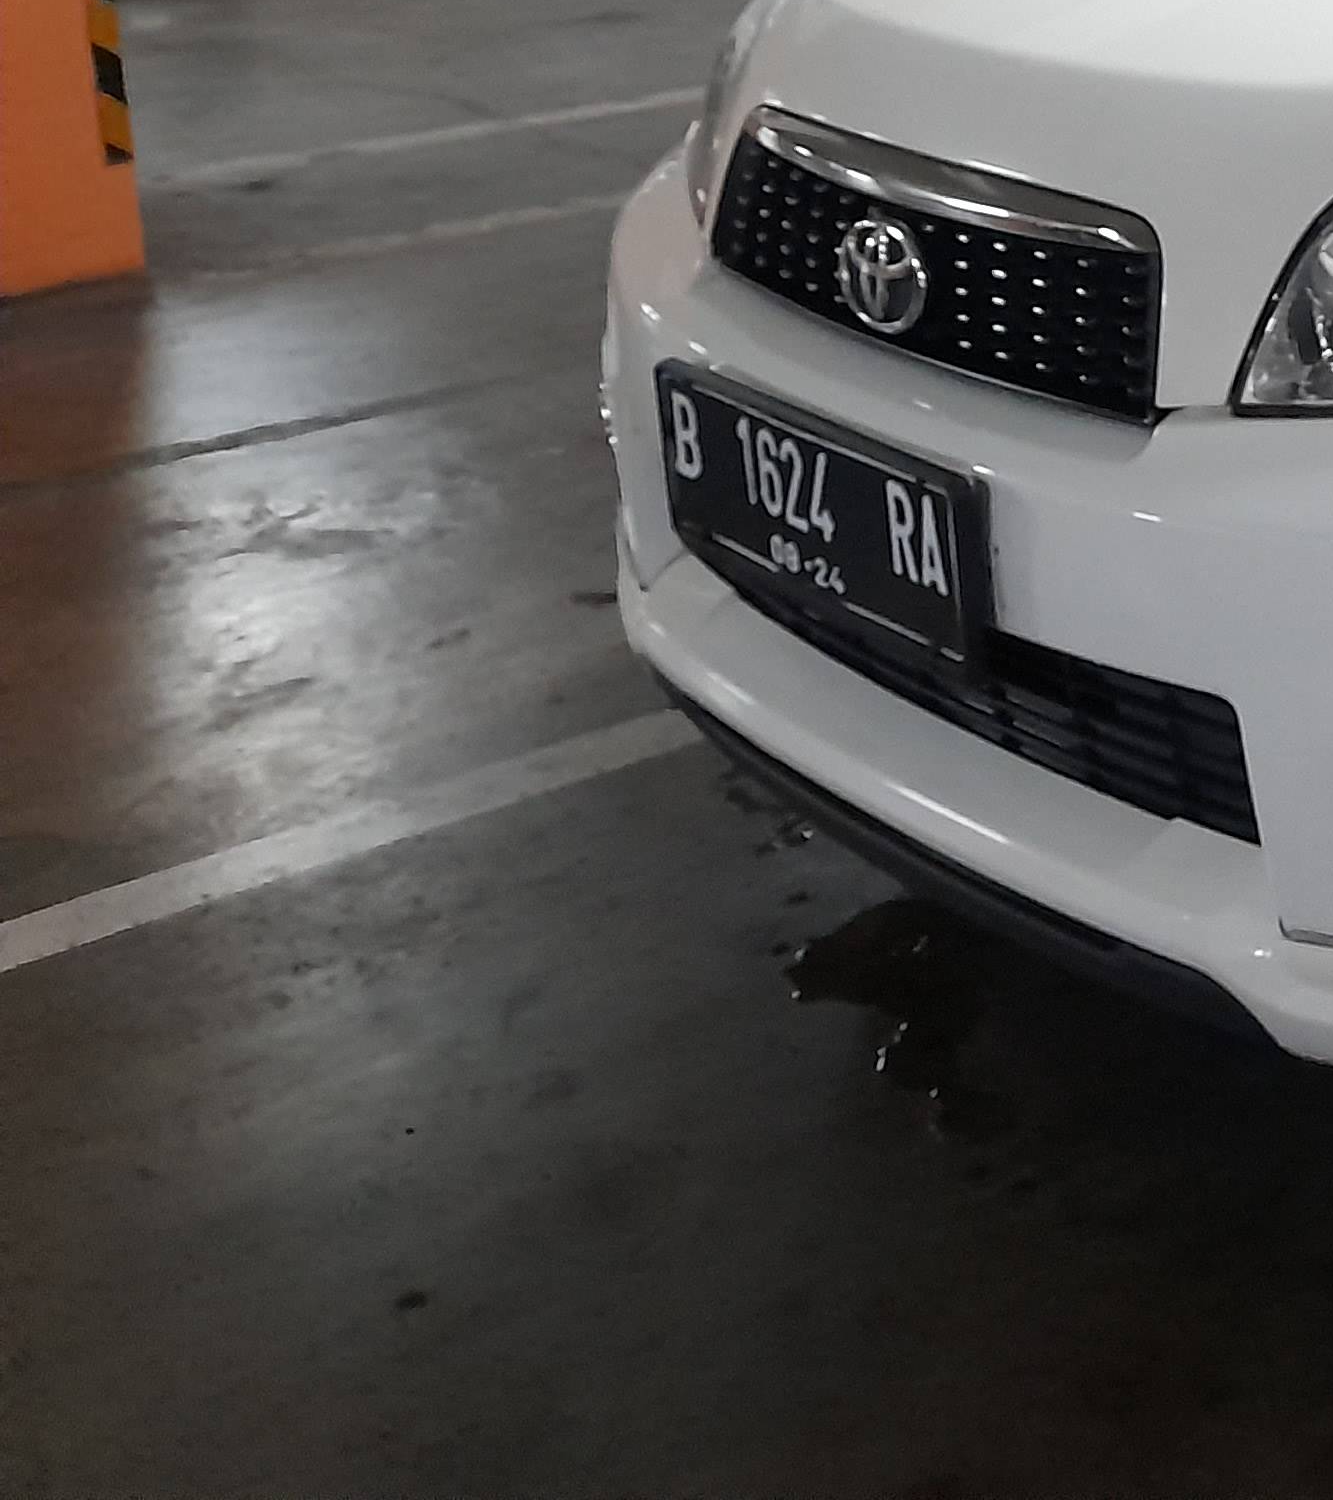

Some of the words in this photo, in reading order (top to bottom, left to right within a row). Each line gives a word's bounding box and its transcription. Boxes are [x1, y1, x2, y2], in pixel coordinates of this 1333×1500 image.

[671, 388, 704, 480] B
[735, 415, 837, 543] 1624
[885, 478, 950, 597] RA
